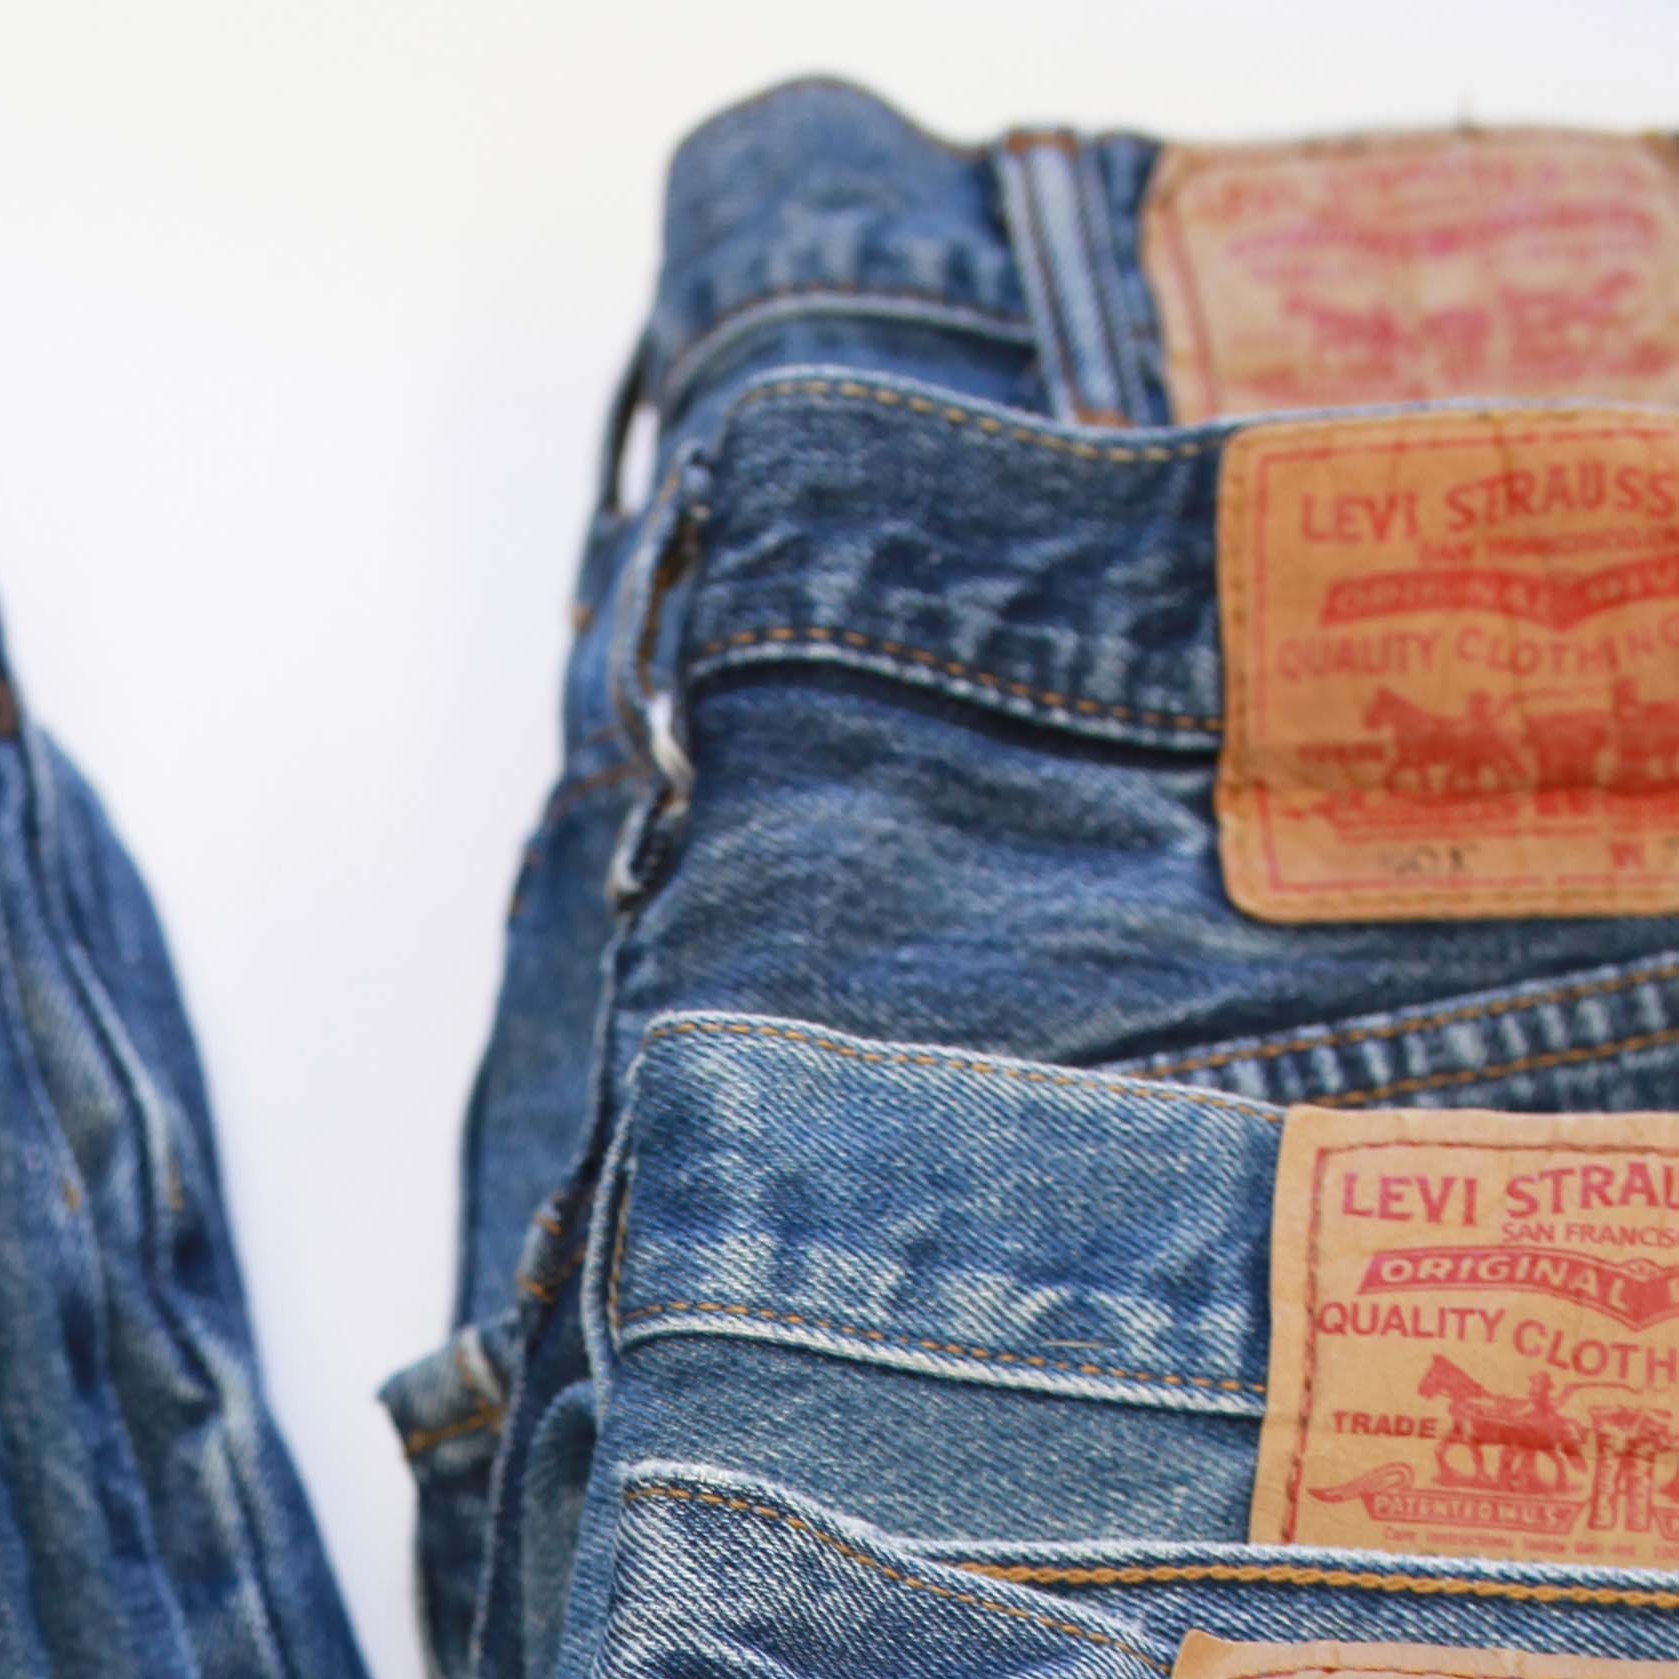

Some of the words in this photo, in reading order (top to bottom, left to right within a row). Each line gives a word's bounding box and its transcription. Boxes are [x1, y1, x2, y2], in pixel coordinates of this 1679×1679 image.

[1300, 492, 1419, 544] LEVI
[1342, 1171, 1477, 1228] LEVI
[1501, 1221, 1555, 1244] SAN
[1380, 1254, 1629, 1313] ORIGINAL
[1318, 1301, 1507, 1345] QUALITY
[1333, 1411, 1439, 1439] TRADE
